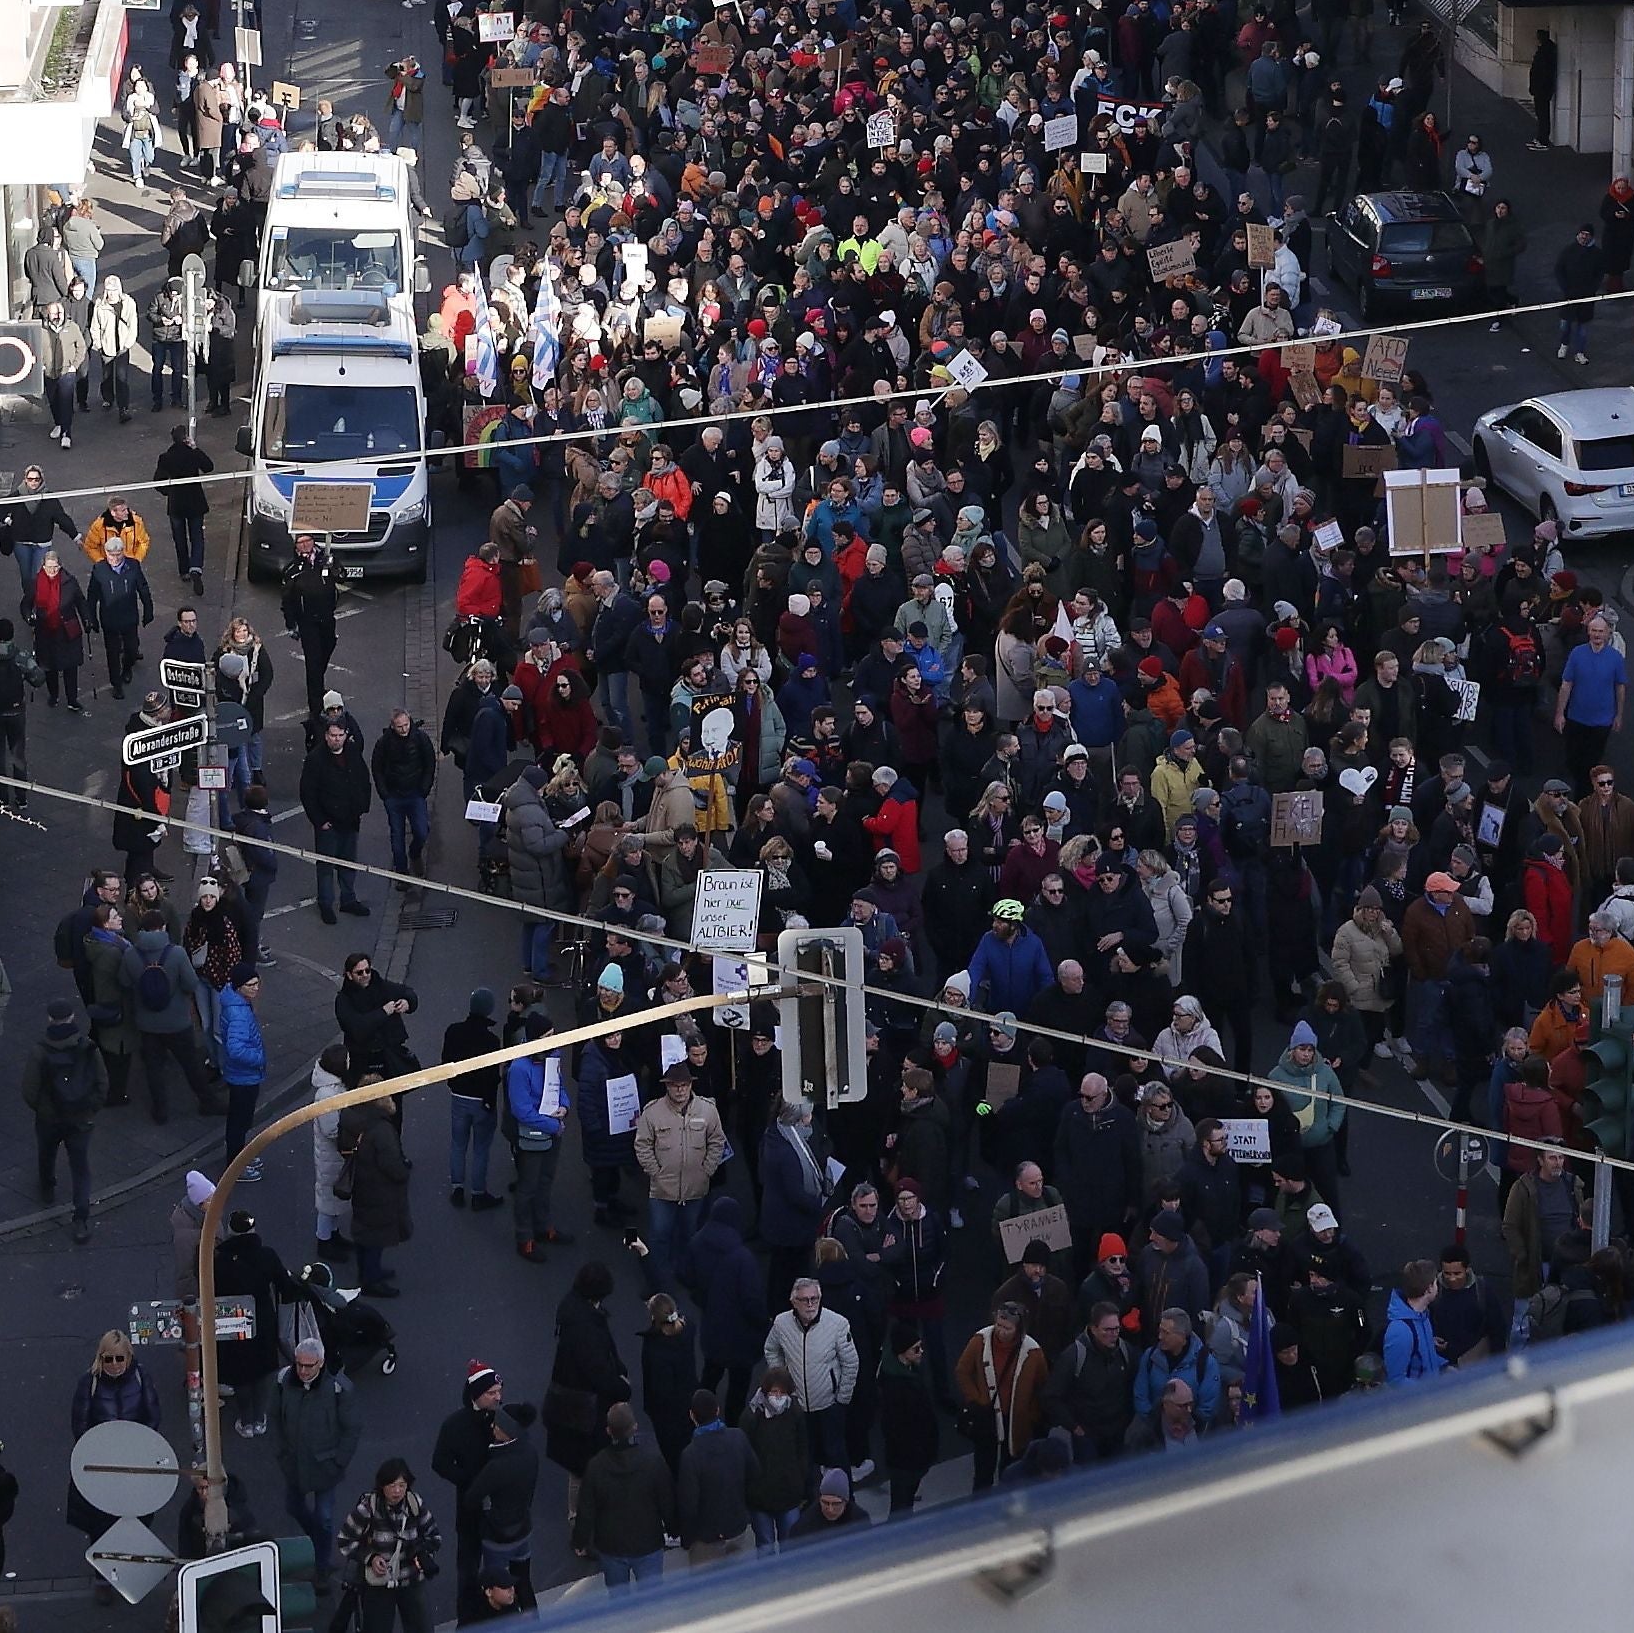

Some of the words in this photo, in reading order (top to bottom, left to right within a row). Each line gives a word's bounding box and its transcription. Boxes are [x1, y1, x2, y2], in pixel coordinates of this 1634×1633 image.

[1371, 336, 1407, 358] AfD
[131, 725, 200, 757] Alexanderstraße
[704, 875, 738, 892] Braun
[740, 878, 755, 890] ist
[703, 897, 722, 909] hier
[726, 898, 745, 910] nur
[700, 915, 728, 923] unser
[696, 920, 754, 939] ALTBIER!
[1233, 1135, 1258, 1146] STATT
